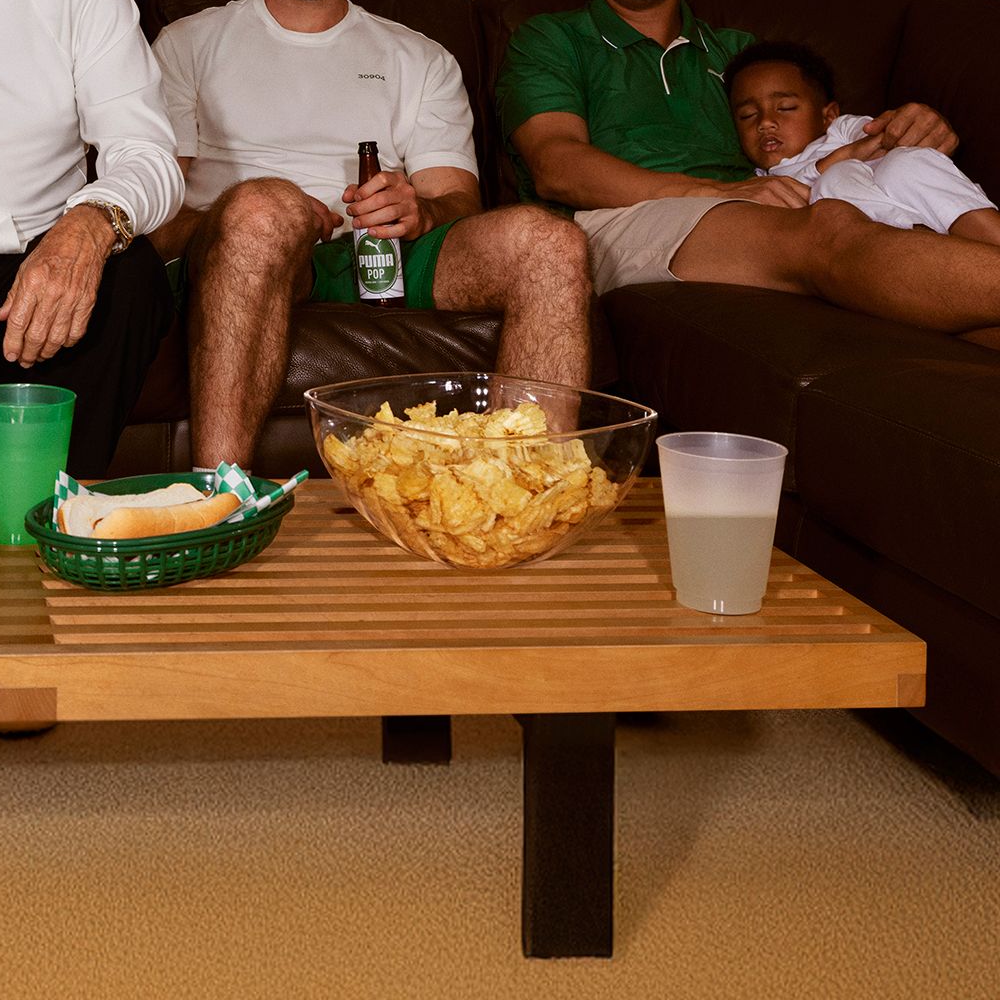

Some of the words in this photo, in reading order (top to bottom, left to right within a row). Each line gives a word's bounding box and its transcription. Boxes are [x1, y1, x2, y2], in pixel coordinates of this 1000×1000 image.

[357, 73, 386, 81] 30904
[358, 253, 394, 268] PUMA
[367, 268, 385, 280] POP
